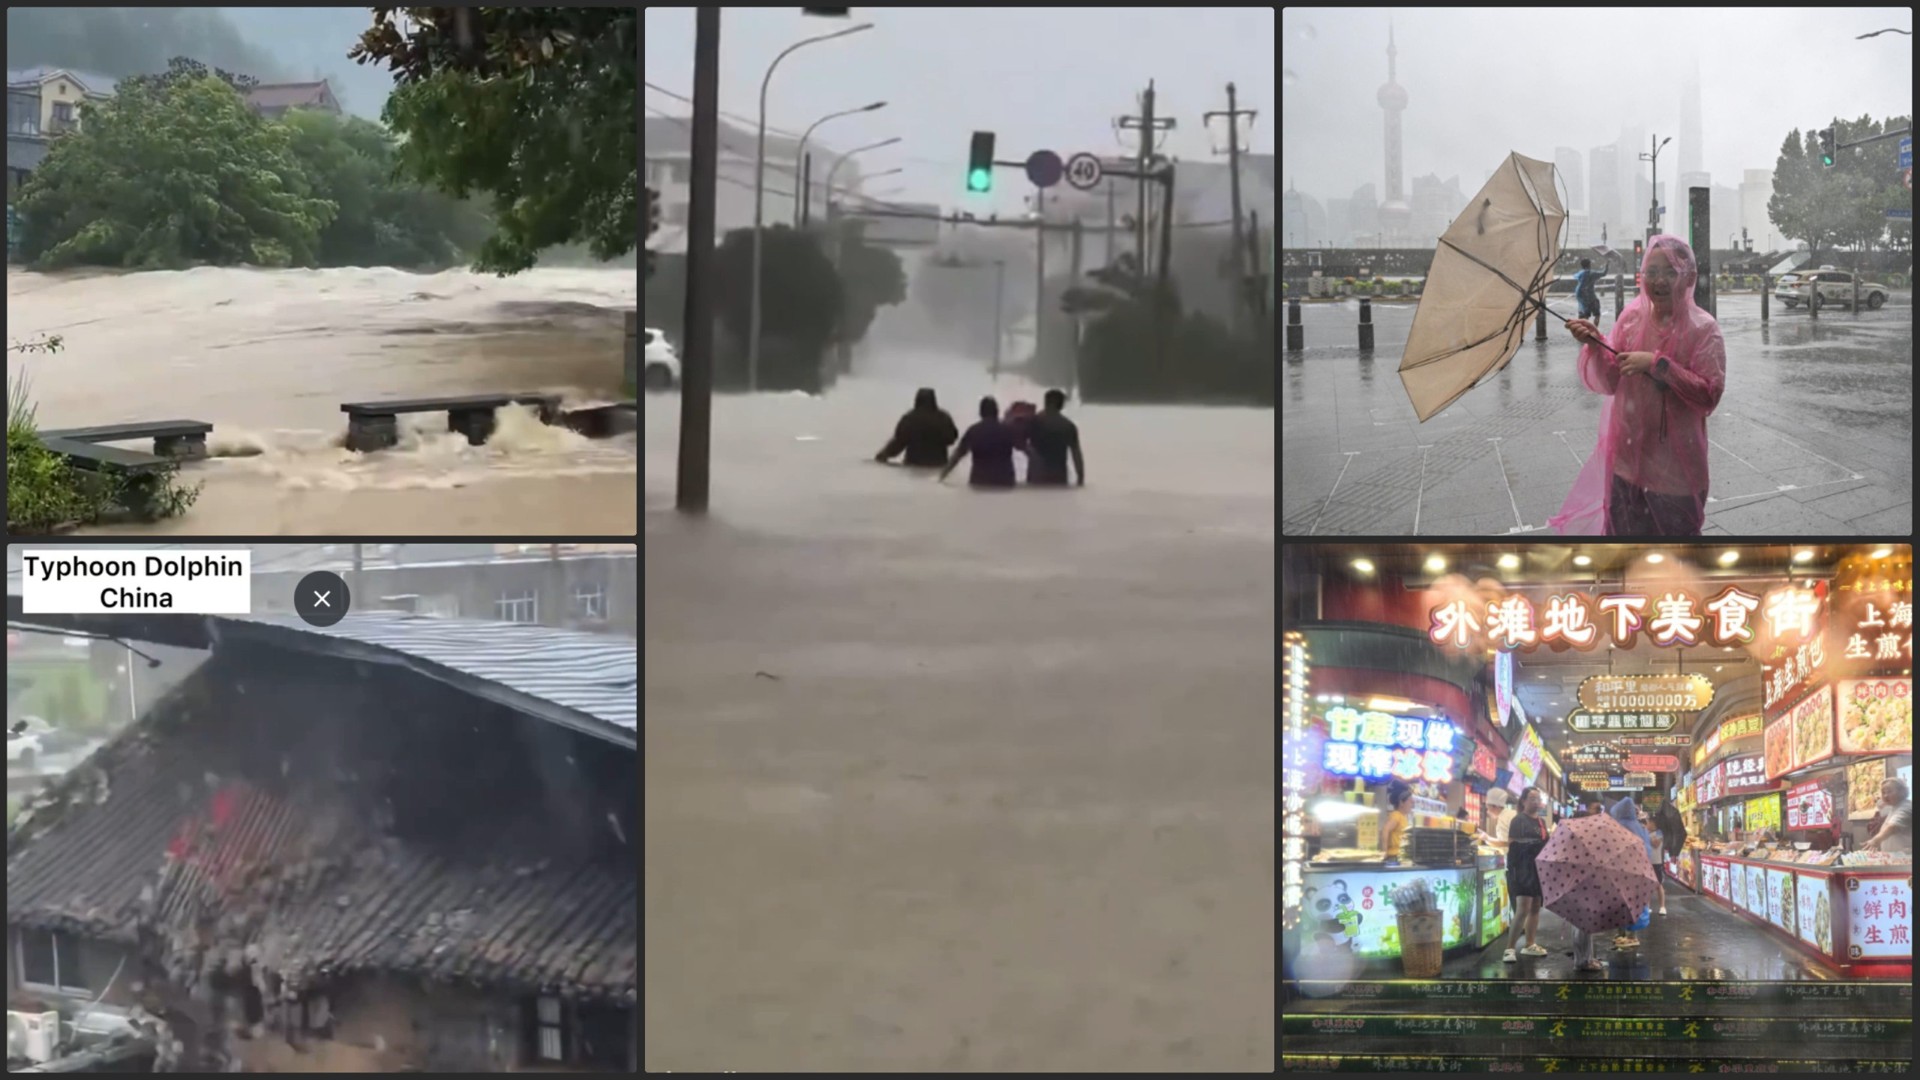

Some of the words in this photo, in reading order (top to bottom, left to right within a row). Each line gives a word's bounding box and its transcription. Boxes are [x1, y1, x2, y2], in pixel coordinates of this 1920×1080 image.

[1073, 161, 1095, 180] 40
[1433, 590, 1819, 645] 外滩地下美食街
[1863, 899, 1907, 919] 鲜肉
[1863, 924, 1911, 945] 生煎
